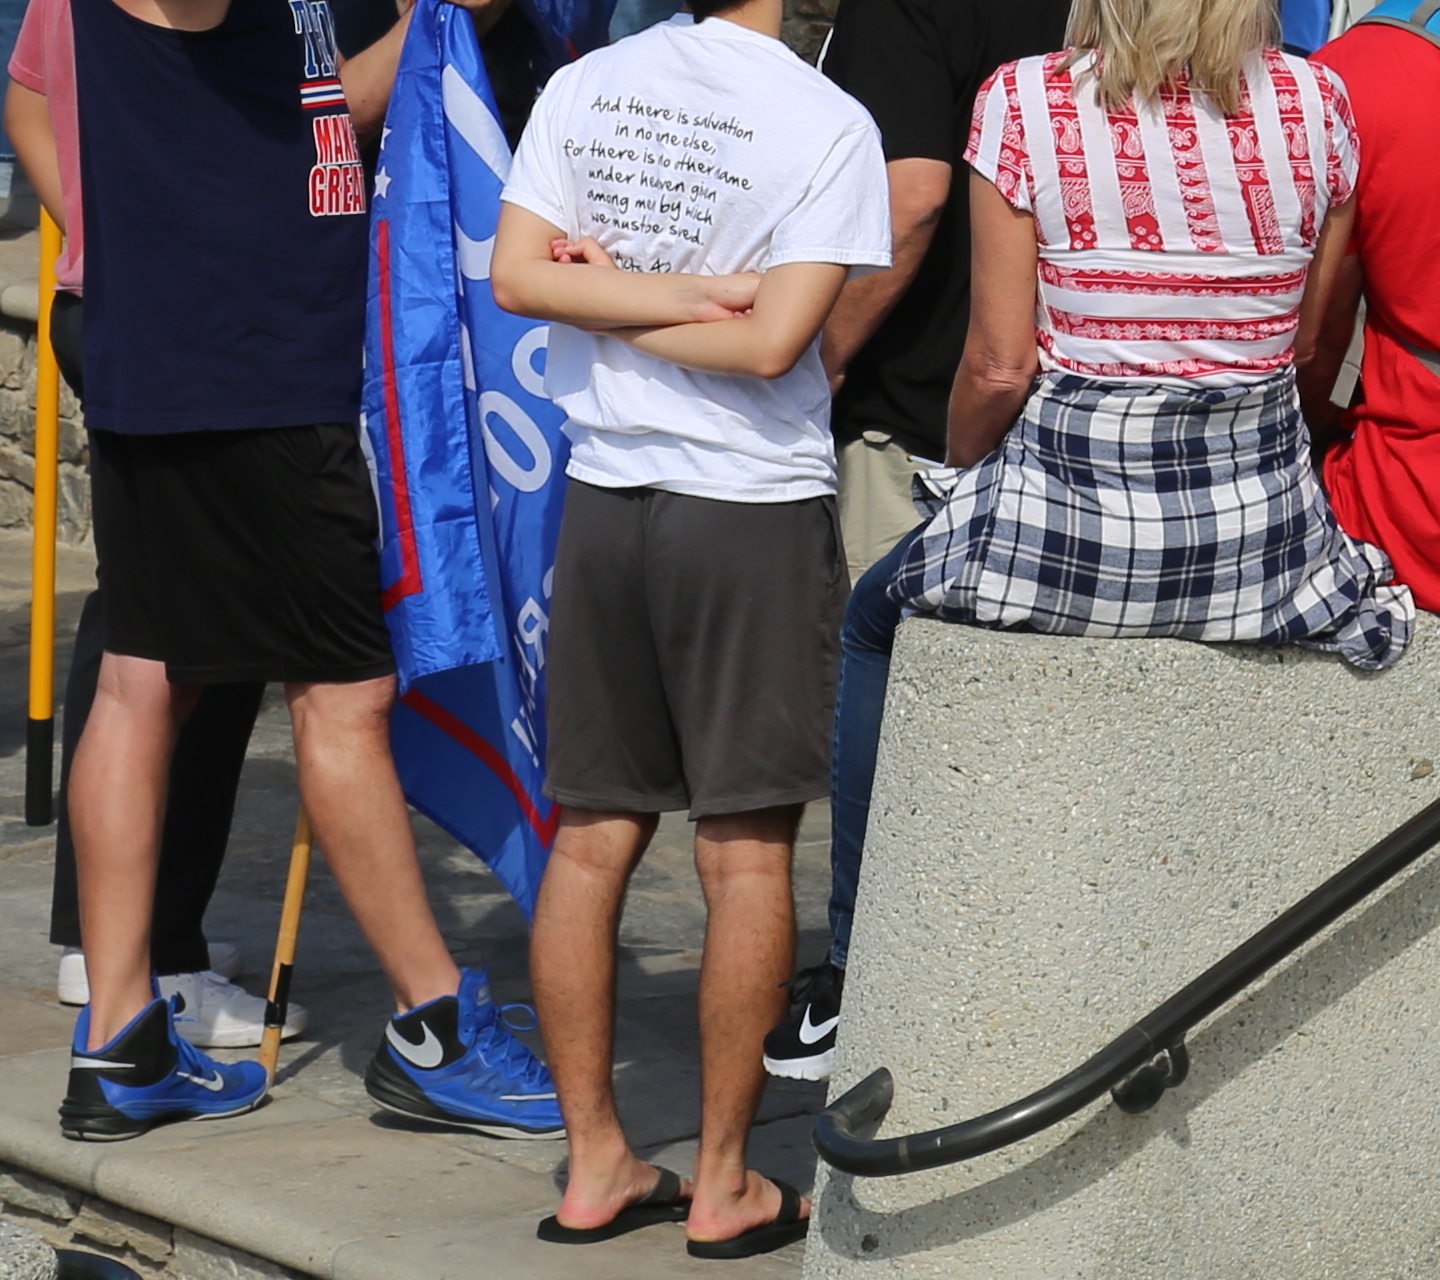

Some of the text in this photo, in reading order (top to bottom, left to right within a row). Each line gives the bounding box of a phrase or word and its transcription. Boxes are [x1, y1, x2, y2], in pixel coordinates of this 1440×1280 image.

[590, 93, 754, 142] And there is salvation
[614, 120, 630, 138] in
[635, 127, 653, 140] no
[562, 138, 586, 159] for
[588, 139, 641, 163] there
[643, 148, 657, 165] is
[674, 152, 712, 177] other
[308, 162, 367, 217] GREA
[588, 165, 634, 184] under
[586, 189, 629, 213] among
[659, 194, 682, 222] by
[591, 213, 612, 225] we
